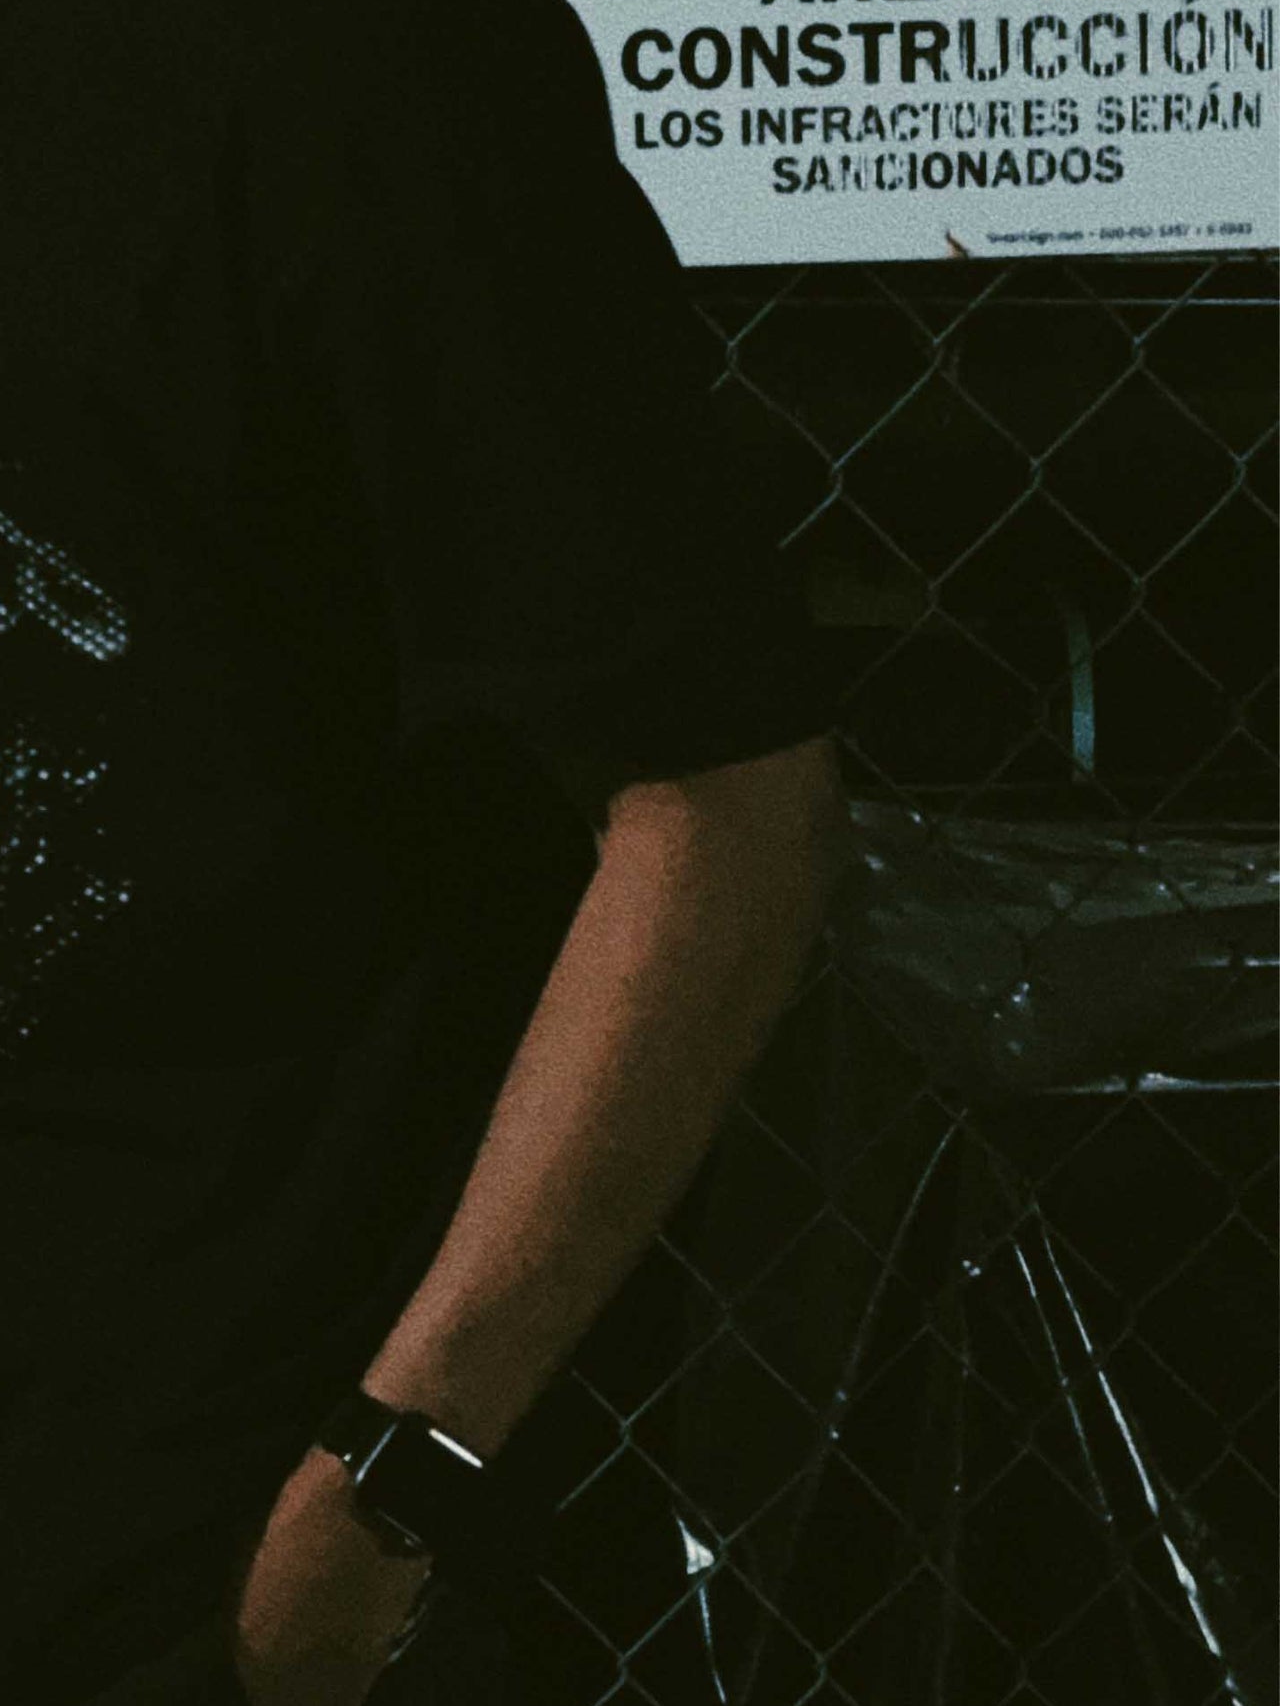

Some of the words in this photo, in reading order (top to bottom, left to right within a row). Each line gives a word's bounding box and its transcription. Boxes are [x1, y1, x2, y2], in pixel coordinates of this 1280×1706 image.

[634, 109, 724, 150] LOS
[740, 96, 1080, 147] INFRACTORES
[1096, 81, 1263, 136] SERÁN
[772, 145, 1125, 194] SANCIONADOS
